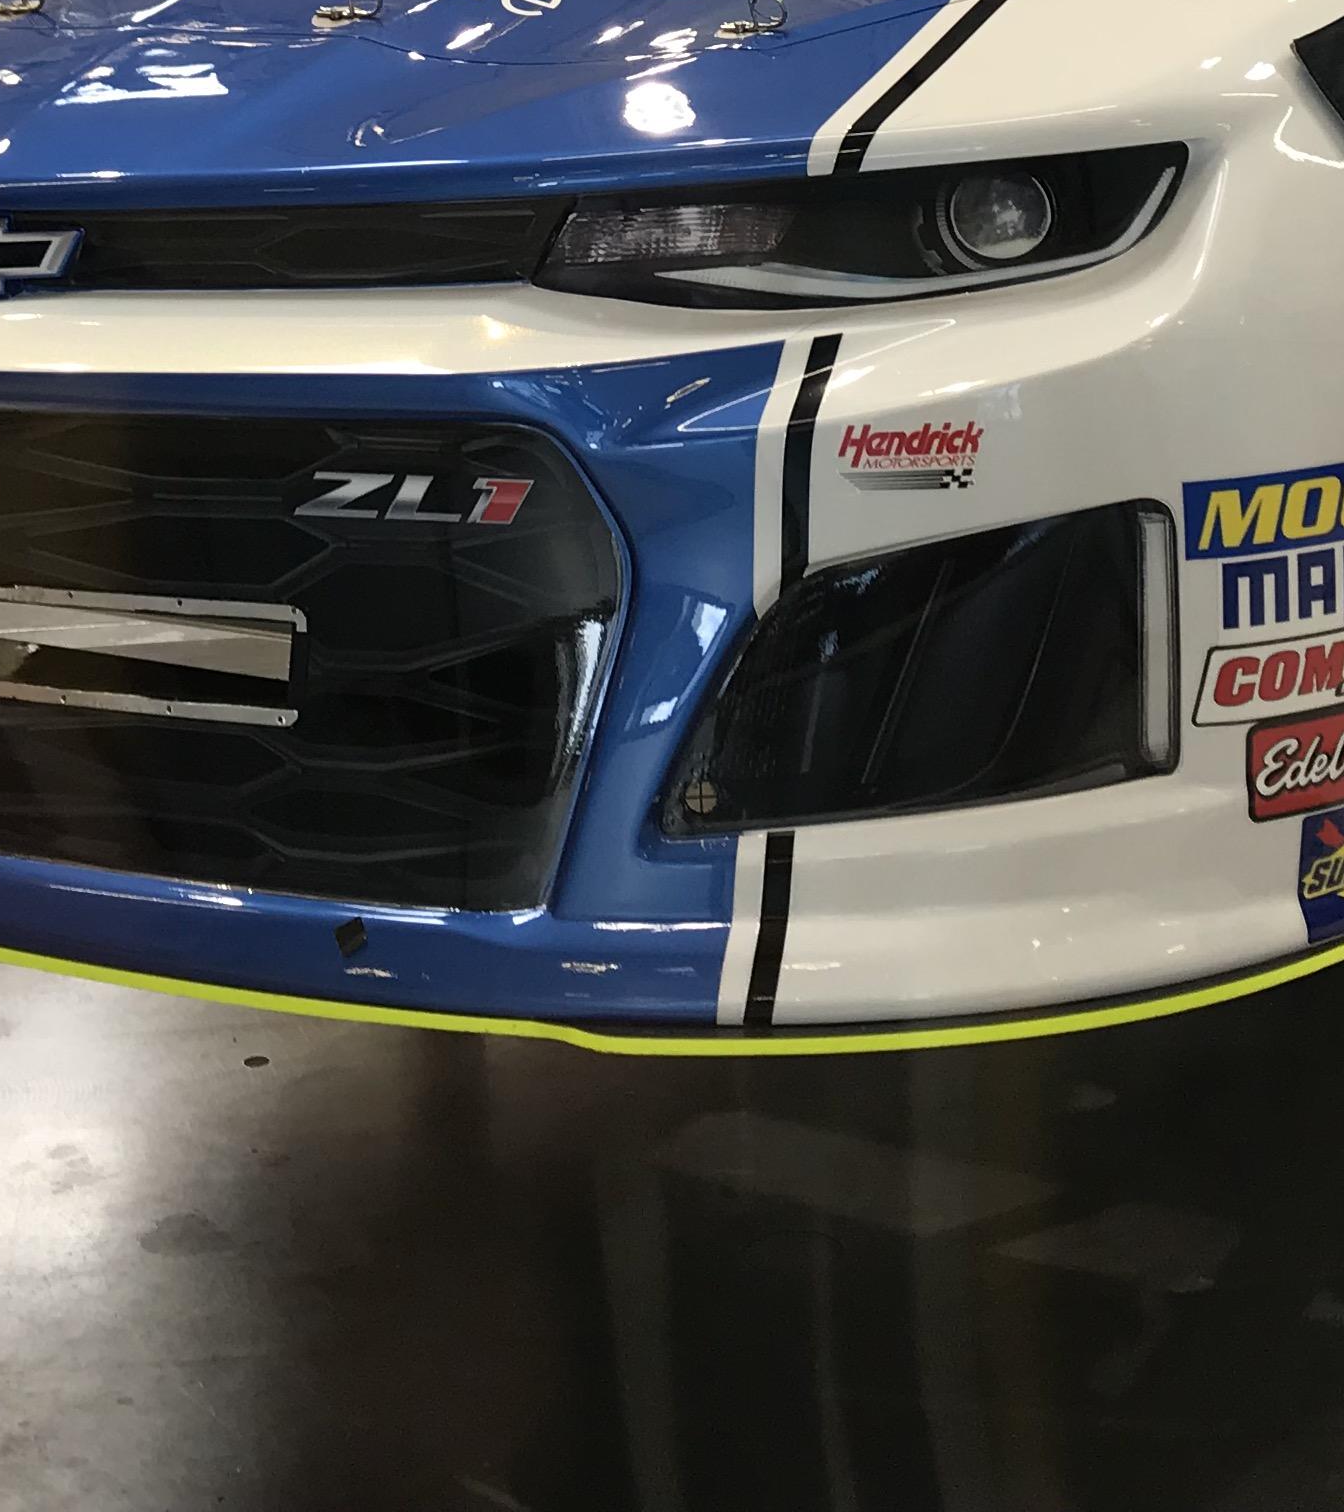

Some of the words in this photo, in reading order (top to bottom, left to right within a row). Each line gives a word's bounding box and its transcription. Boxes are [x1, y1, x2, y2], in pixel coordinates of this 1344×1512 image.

[838, 421, 984, 468] Hendrick
[863, 455, 975, 469] MOTORSPORTS
[293, 471, 535, 525] ZL1
